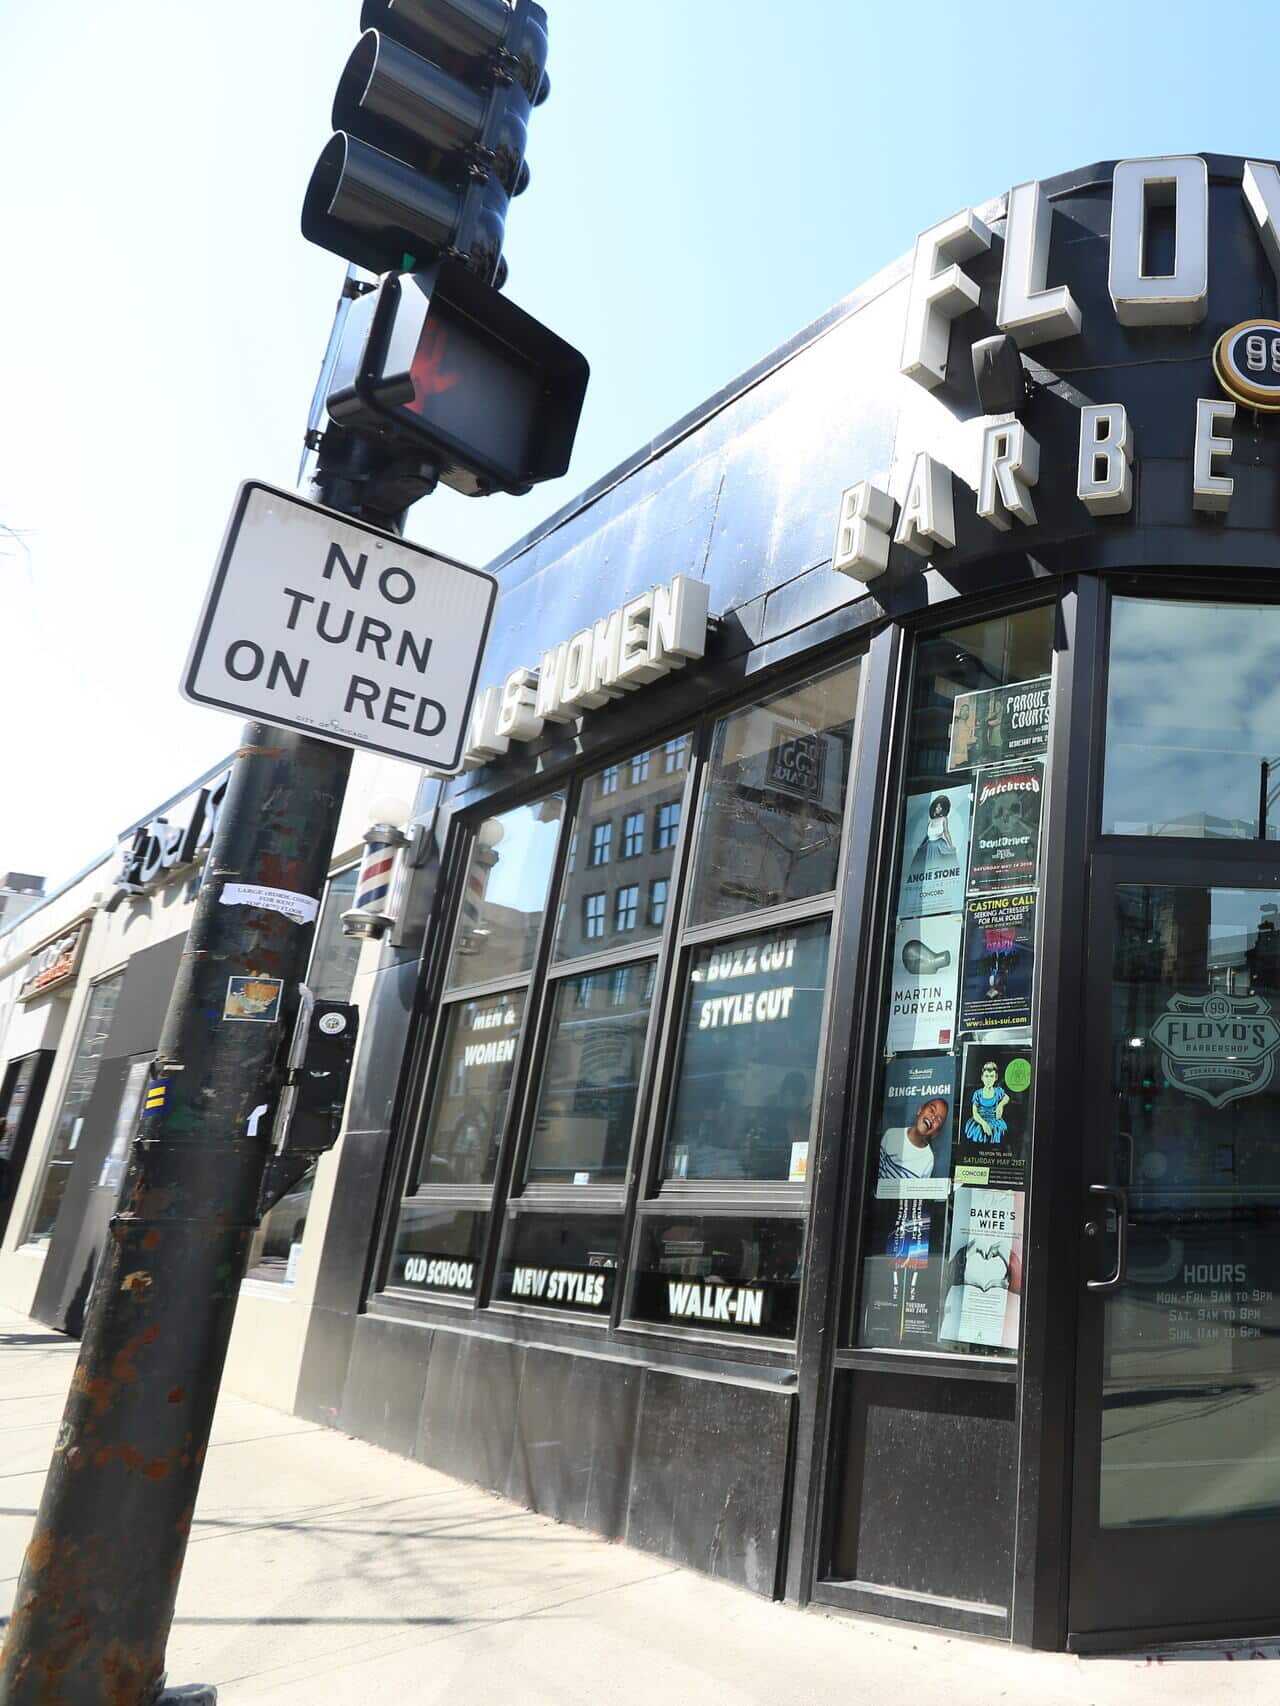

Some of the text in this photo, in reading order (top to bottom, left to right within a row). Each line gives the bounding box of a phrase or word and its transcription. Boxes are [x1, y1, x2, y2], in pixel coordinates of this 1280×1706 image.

[322, 542, 416, 605] NO
[282, 587, 433, 675] TURN
[534, 574, 710, 724] WOMEN
[224, 639, 310, 698] ON
[344, 674, 447, 738] RED
[1011, 707, 1050, 729] COURTS
[906, 868, 960, 883] ANGIE STONE
[969, 895, 1034, 912] CASTING CALL
[707, 938, 797, 982] BUZZ CUT
[894, 987, 941, 1001] MARTIN
[472, 1007, 503, 1031] MEN
[699, 987, 794, 1030] STYLE CUT
[893, 1000, 953, 1016] PURYEAR
[1210, 1001, 1225, 1014] 99
[1166, 1021, 1265, 1048] FLOYD'S
[464, 1039, 514, 1066] WOMEN
[888, 1083, 951, 1098] BINGE-LAUGH
[970, 1208, 1016, 1221] BAKER'S
[979, 1220, 1005, 1230] WIFE
[404, 1257, 473, 1290] OLD SCHOOL
[512, 1267, 604, 1305] NEW STYLES
[1184, 1264, 1247, 1284] HOURS
[668, 1282, 764, 1326] WALK-IN
